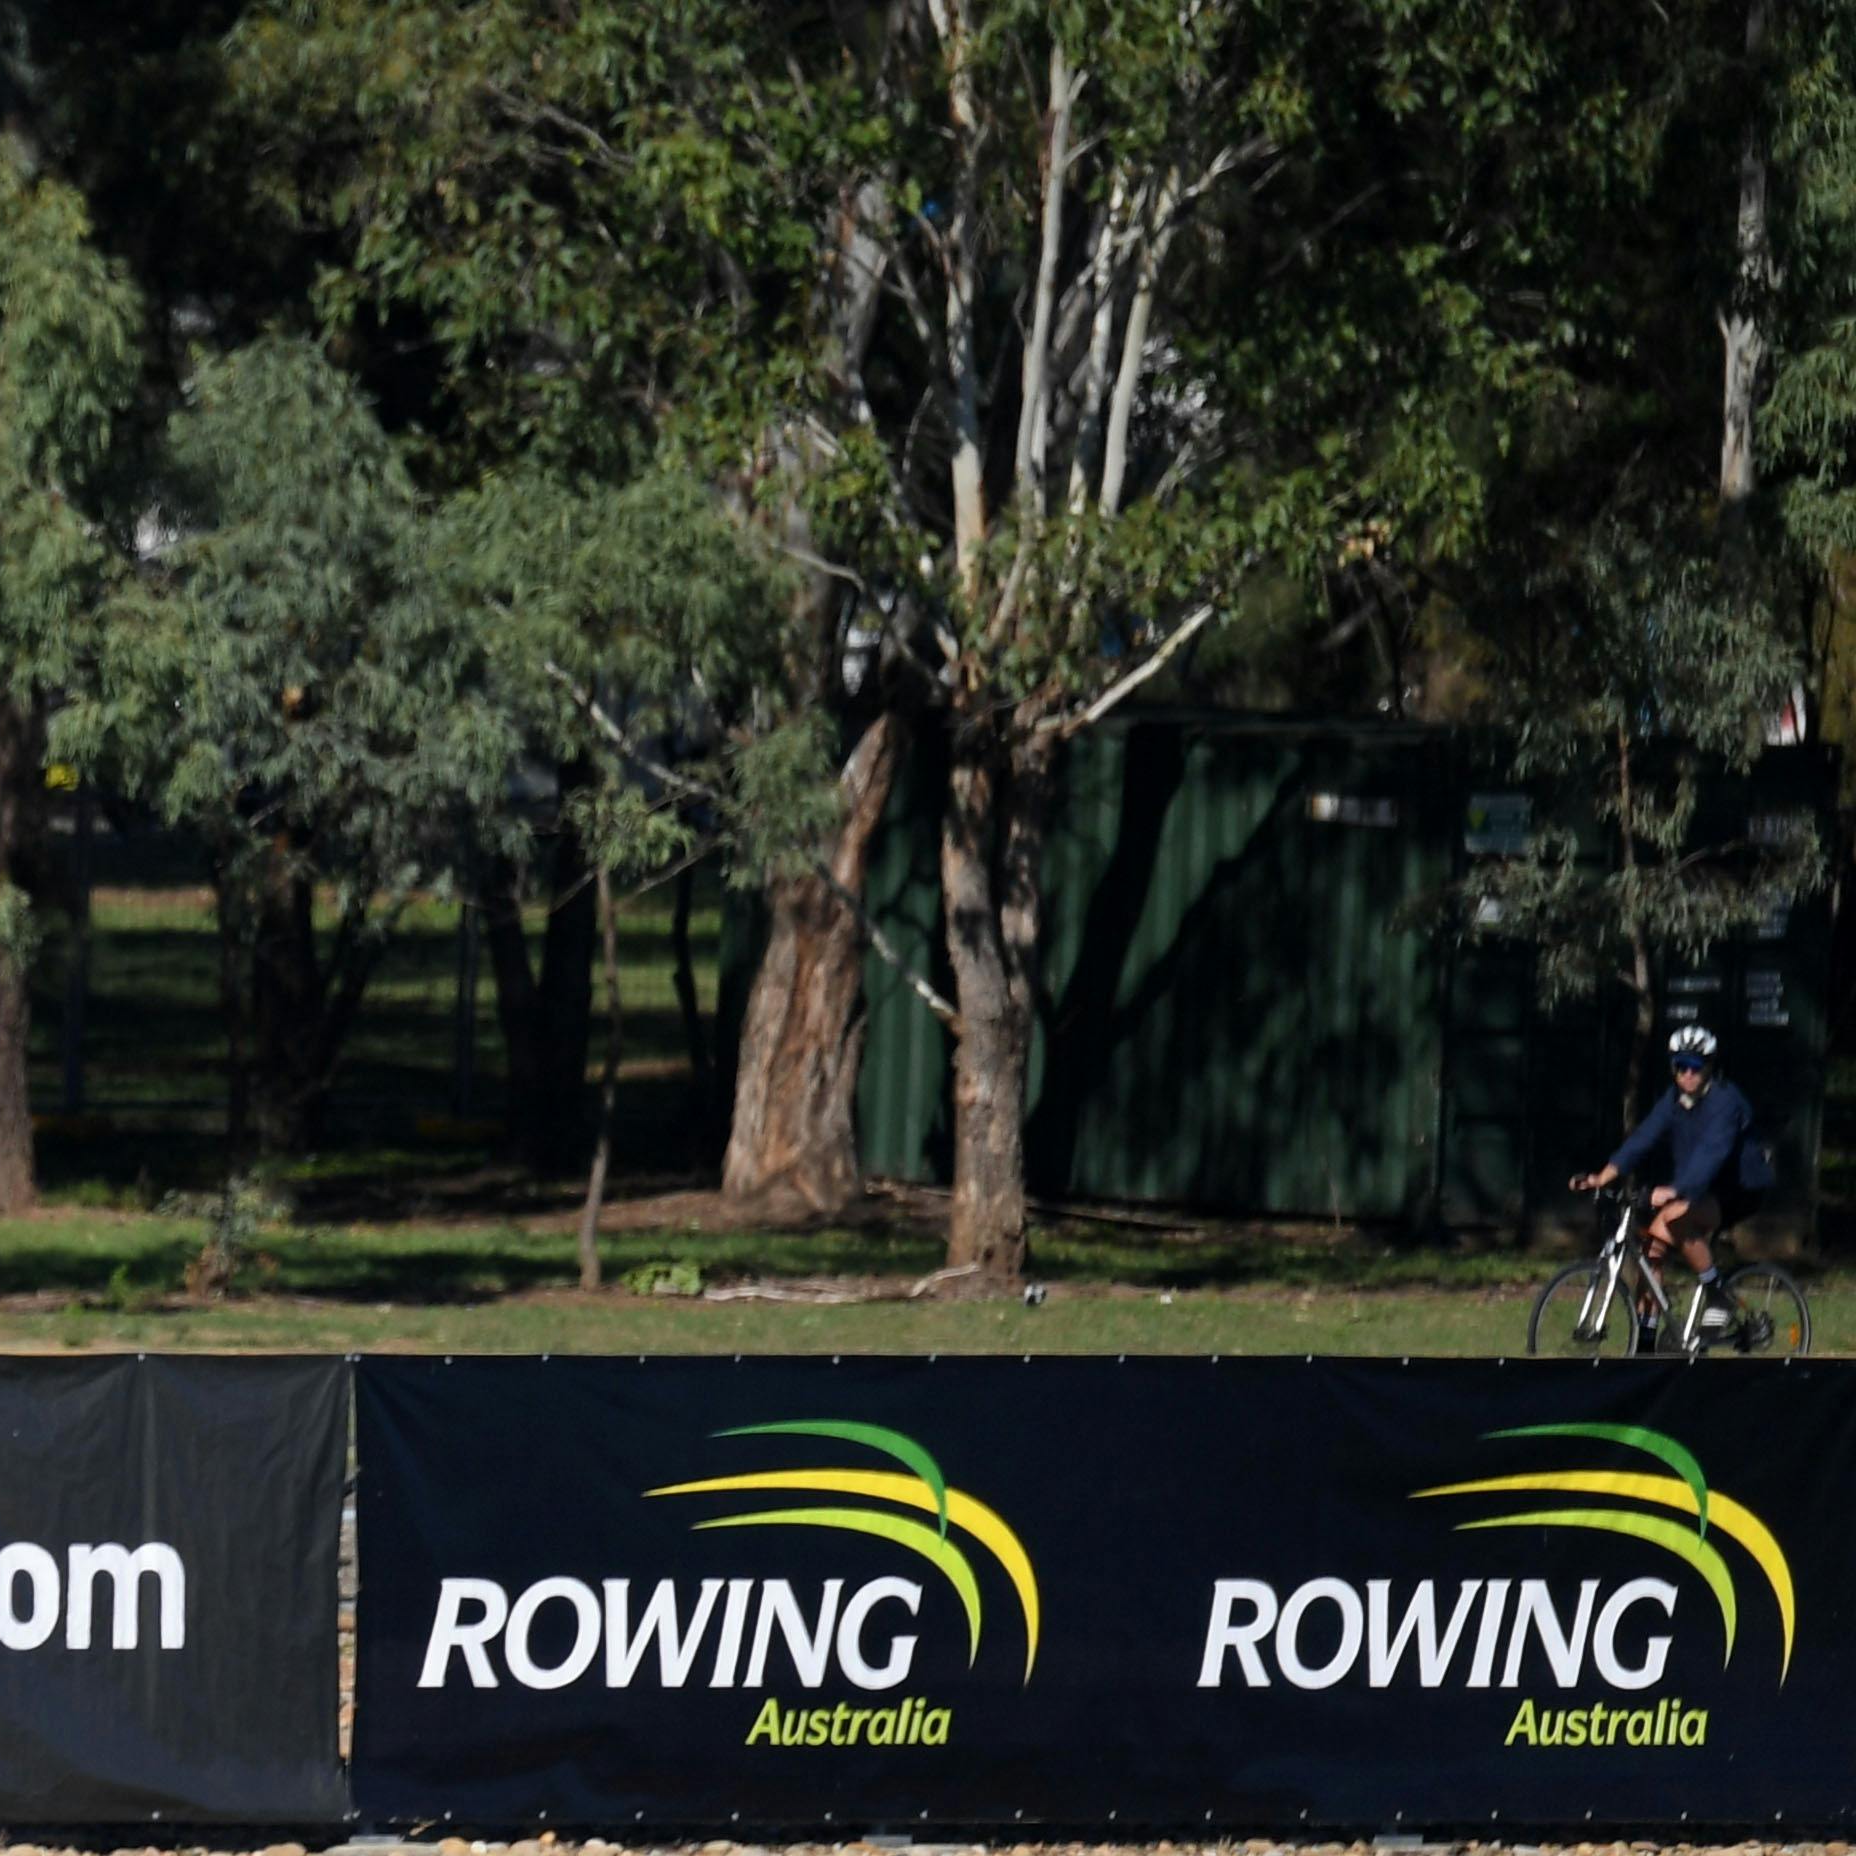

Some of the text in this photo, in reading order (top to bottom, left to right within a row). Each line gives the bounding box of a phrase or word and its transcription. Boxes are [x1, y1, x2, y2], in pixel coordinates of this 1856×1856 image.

[417, 1576, 923, 1690] ROWING
[1197, 1577, 1678, 1690] ROWING
[745, 1697, 952, 1747] Australia
[1503, 1698, 1709, 1747] Australia
